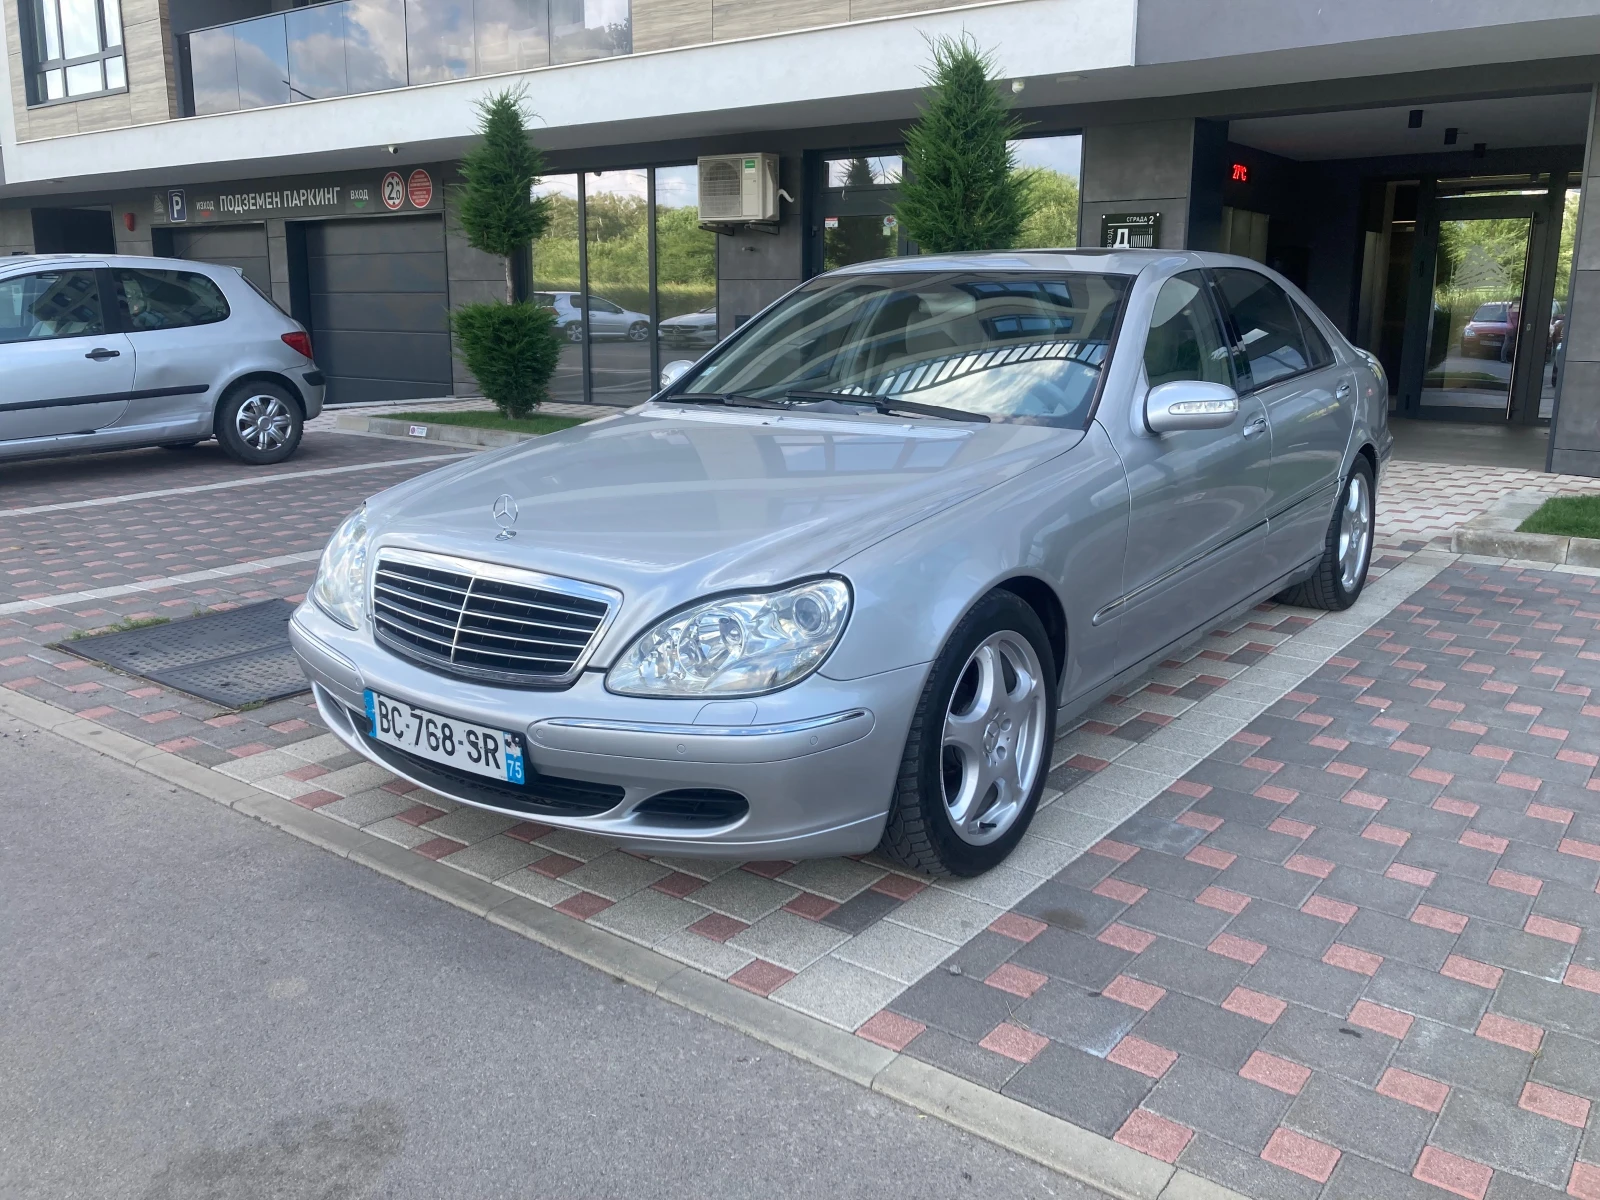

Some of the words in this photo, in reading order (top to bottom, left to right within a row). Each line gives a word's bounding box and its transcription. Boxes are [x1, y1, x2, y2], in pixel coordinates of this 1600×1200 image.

[220, 191, 280, 213] ПОДЗЕМЕН
[283, 186, 340, 207] ПАРКИНГ
[350, 190, 368, 200] ВХОД
[172, 196, 182, 218] P
[196, 200, 214, 211] ИЗХОД
[1148, 215, 1155, 225] 2
[1106, 228, 1114, 249] ВХОД
[1112, 228, 1130, 248] Д
[377, 699, 501, 770] BC-768-SR
[507, 760, 523, 779] 75
